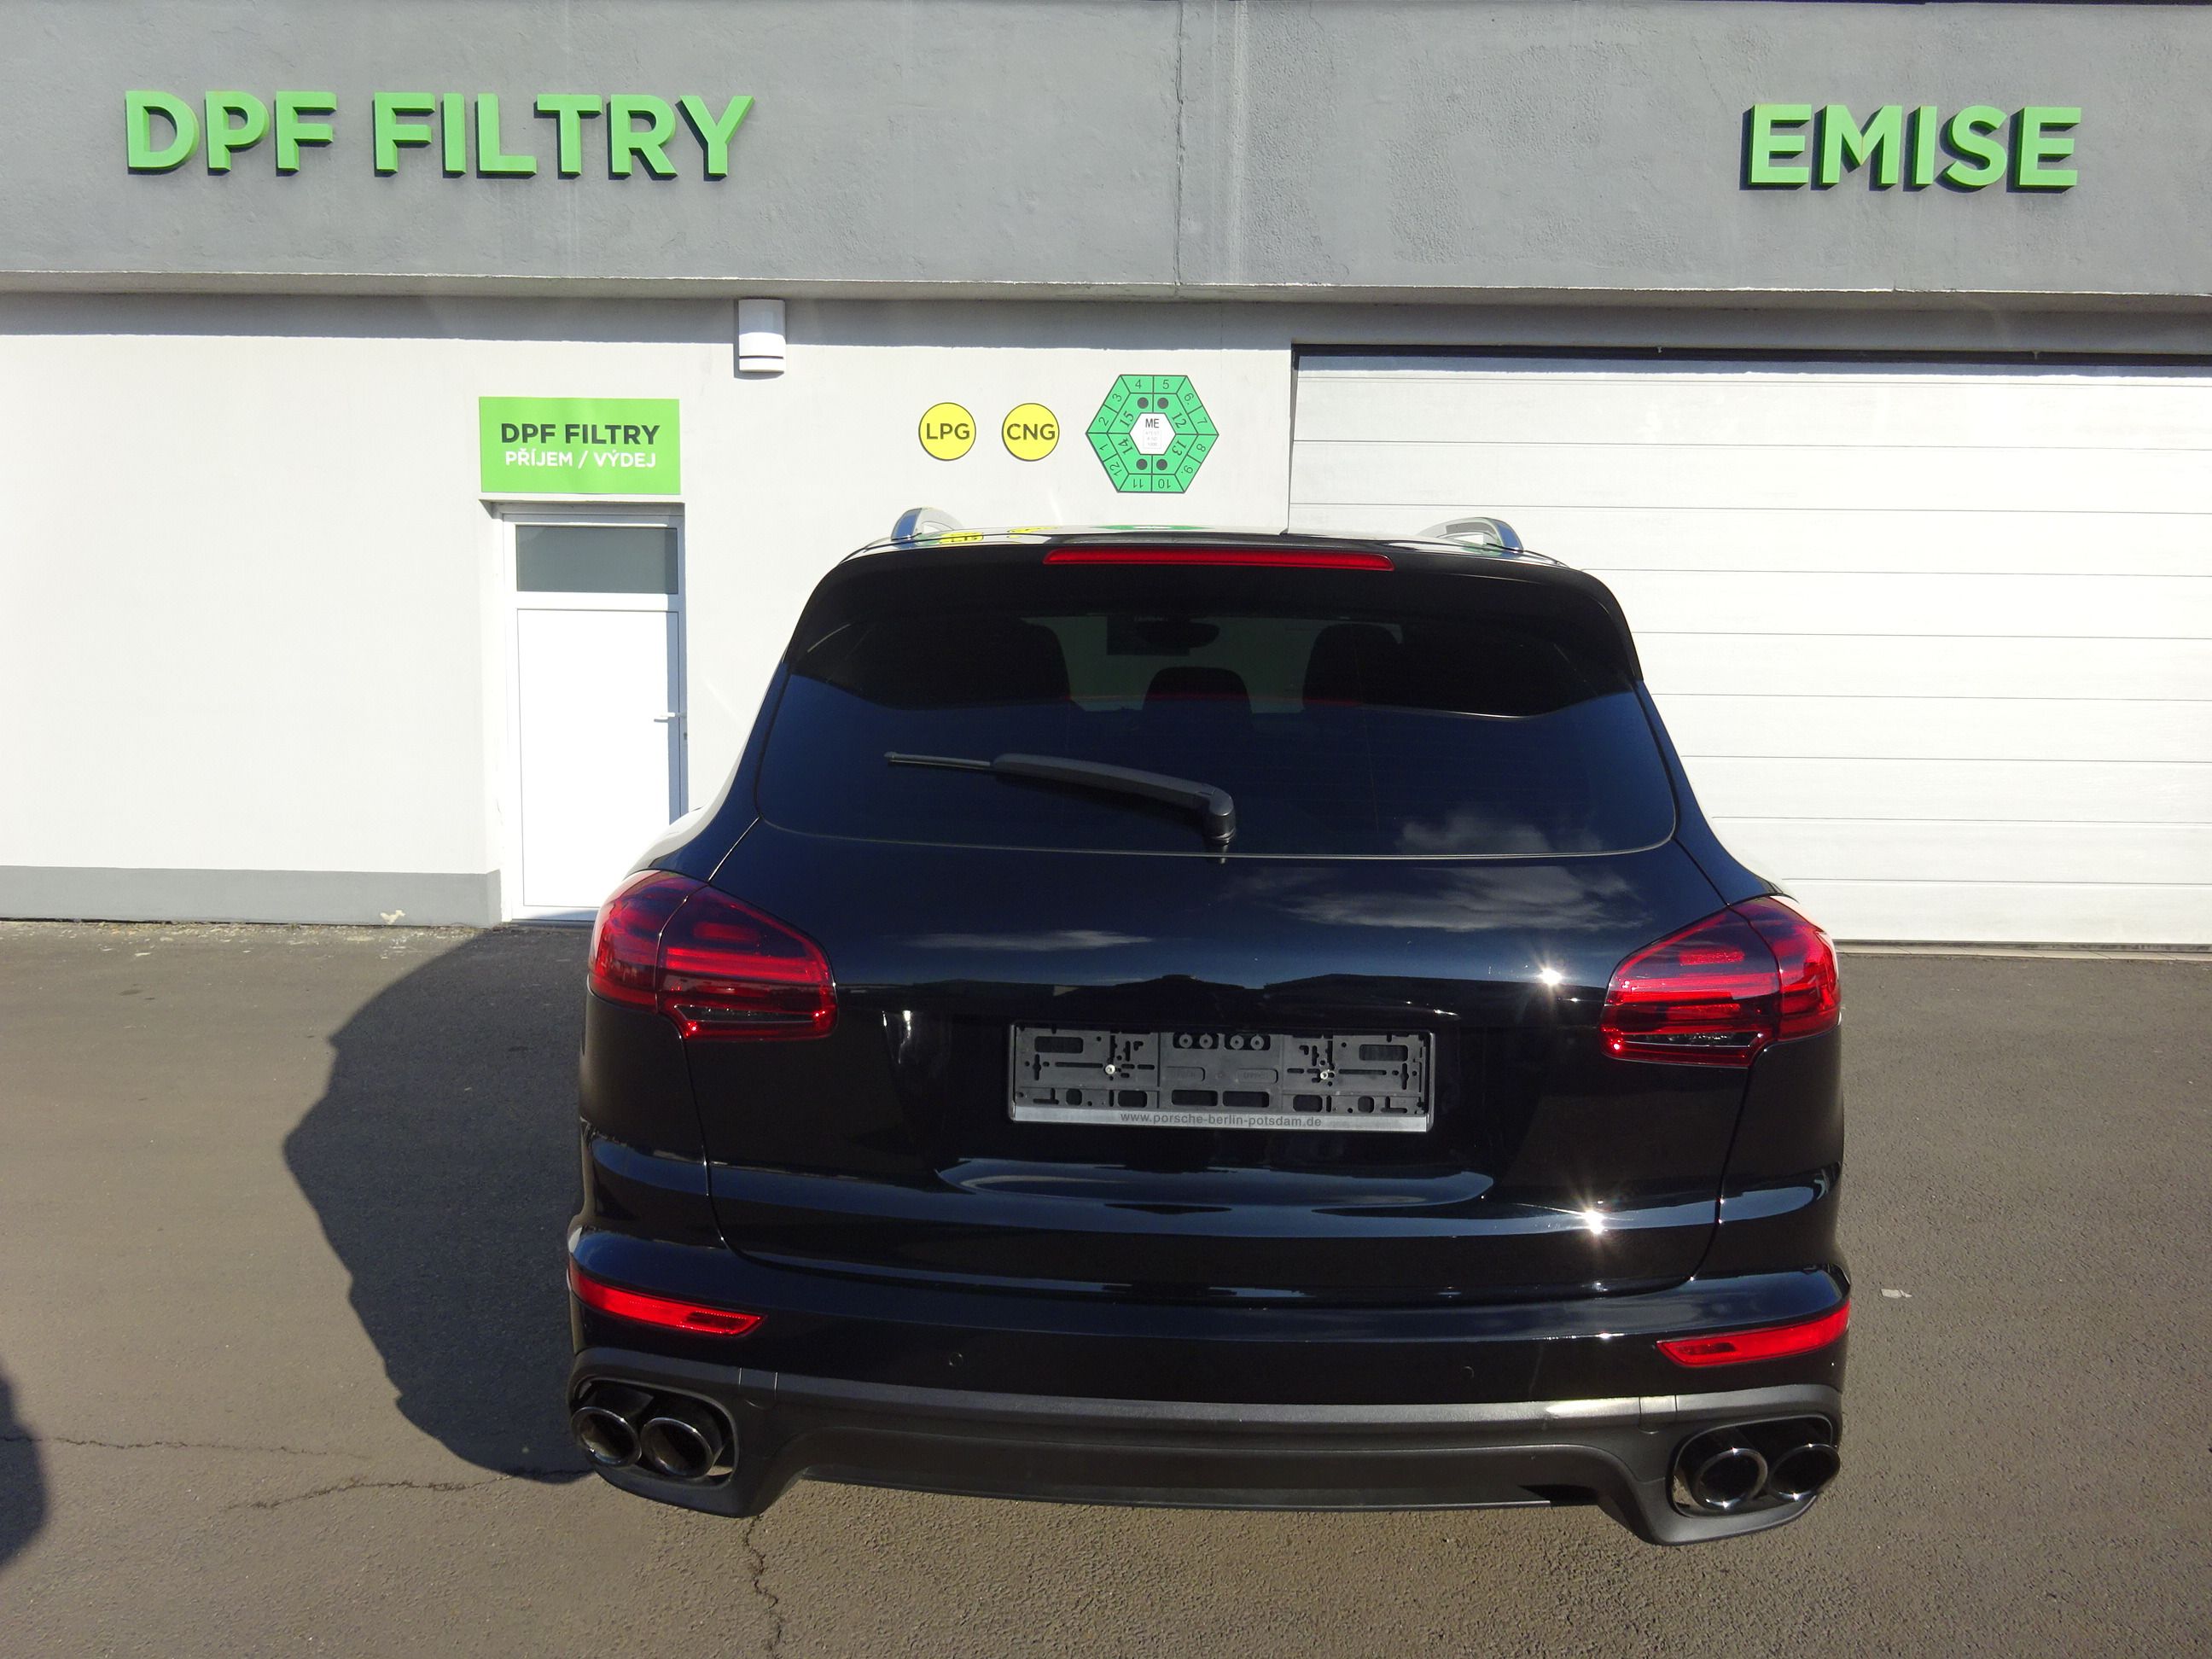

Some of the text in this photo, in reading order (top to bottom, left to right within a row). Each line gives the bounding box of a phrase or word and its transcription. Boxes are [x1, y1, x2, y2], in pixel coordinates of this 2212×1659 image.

[125, 90, 755, 179] DPF FILTRY
[1747, 103, 2081, 187] EMISE
[1135, 379, 1142, 389] 4
[1162, 379, 1170, 390] 5
[1112, 393, 1122, 402] 3
[1098, 416, 1109, 427] 2
[1120, 410, 1134, 428] 15
[1145, 418, 1160, 428] ME
[1172, 412, 1187, 428] 12
[1196, 417, 1208, 426] 7
[501, 423, 661, 445] DPF FILTRY
[926, 422, 970, 440] LPG
[1006, 423, 1056, 440] CNG
[1118, 439, 1134, 455] 14
[1172, 439, 1187, 456] 13
[1196, 444, 1206, 452] 8
[505, 448, 656, 469] PŘÍJEM / VÝDEJ
[1109, 462, 1122, 476] 12
[1132, 479, 1144, 488] 11
[1157, 479, 1172, 489] 10
[1121, 1112, 1322, 1127] www.porsche-berlin-potsdam.de
